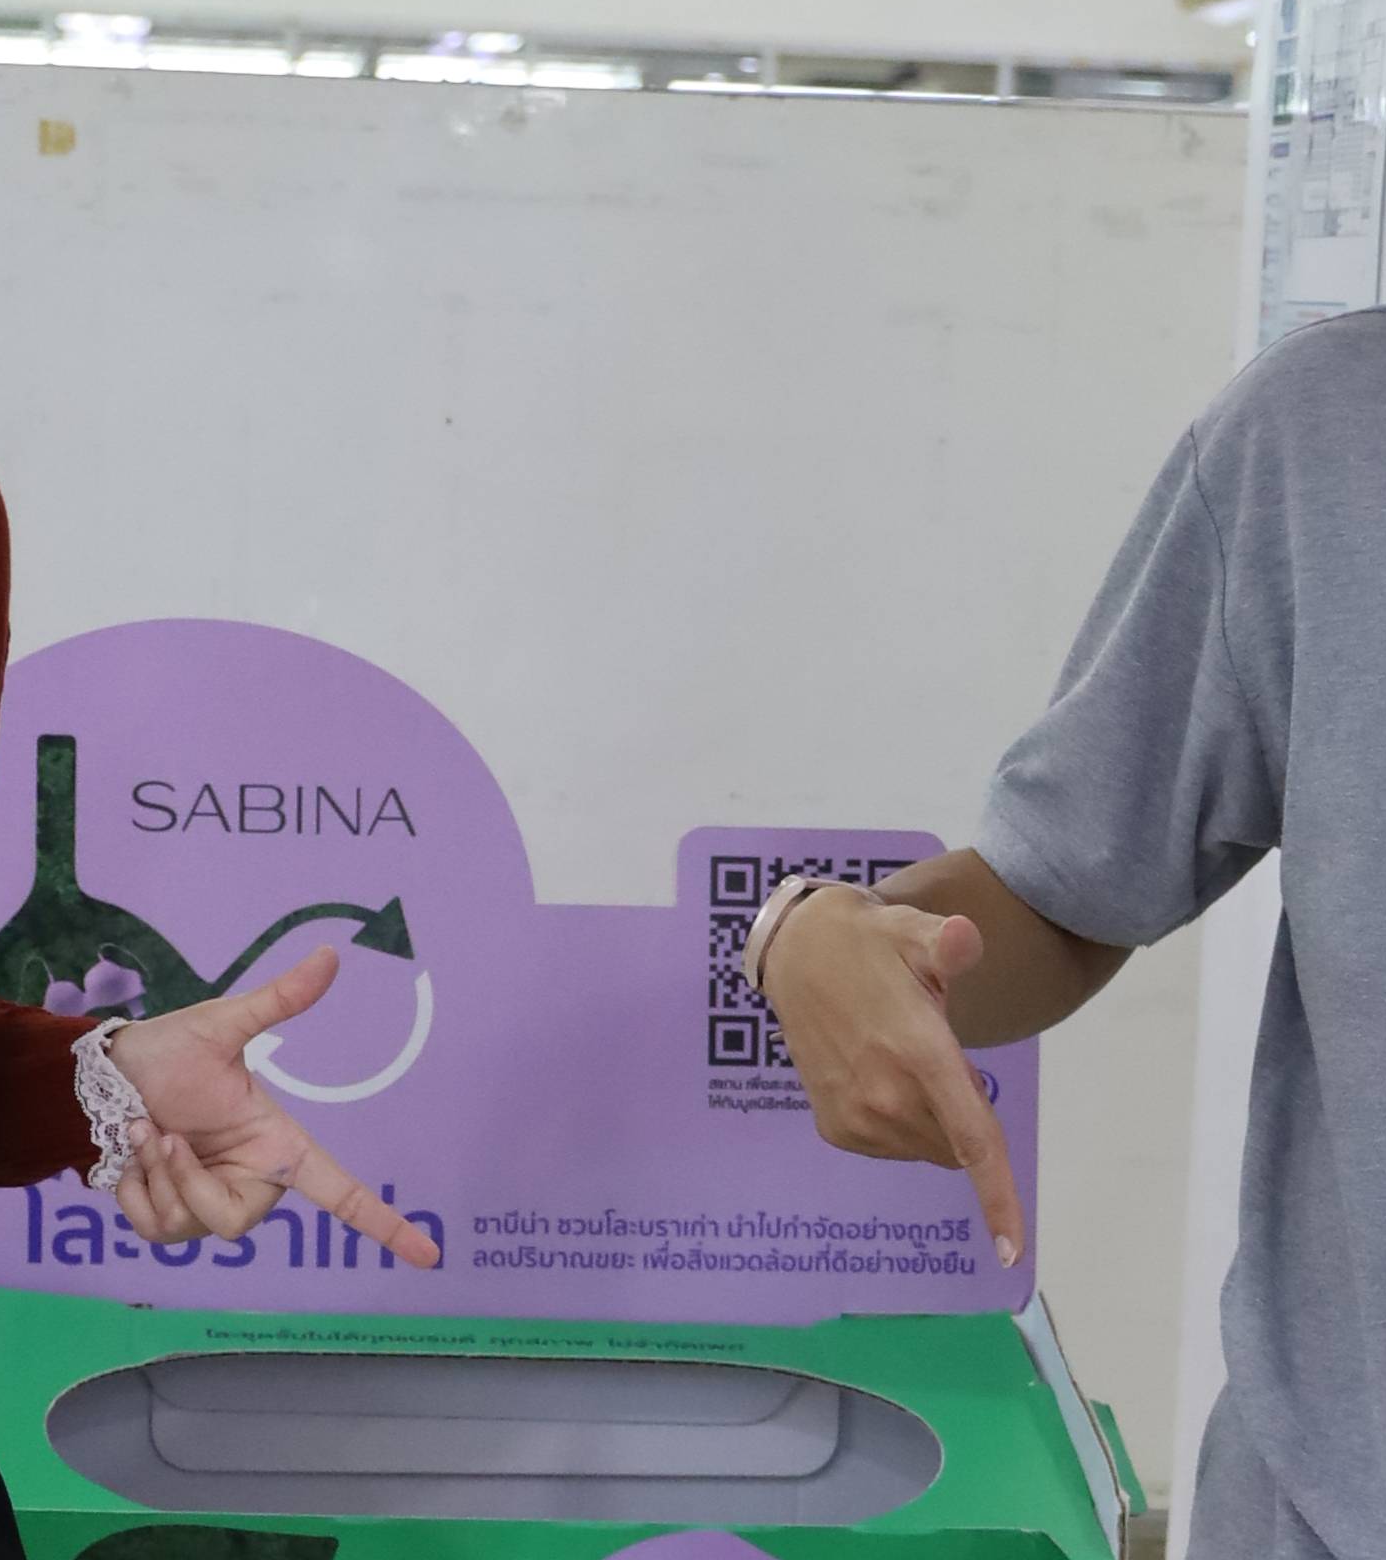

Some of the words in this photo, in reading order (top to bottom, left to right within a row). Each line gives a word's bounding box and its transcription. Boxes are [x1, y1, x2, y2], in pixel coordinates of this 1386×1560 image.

[131, 780, 417, 838] SABINA
[473, 1209, 550, 1235] ซาบีน่า
[557, 1208, 719, 1237] ชวนโละบราเก่า
[727, 1210, 971, 1249] นำไปกำจัดอย่างถูกวิธี
[473, 1245, 635, 1270] ลดปริมาณขยะ
